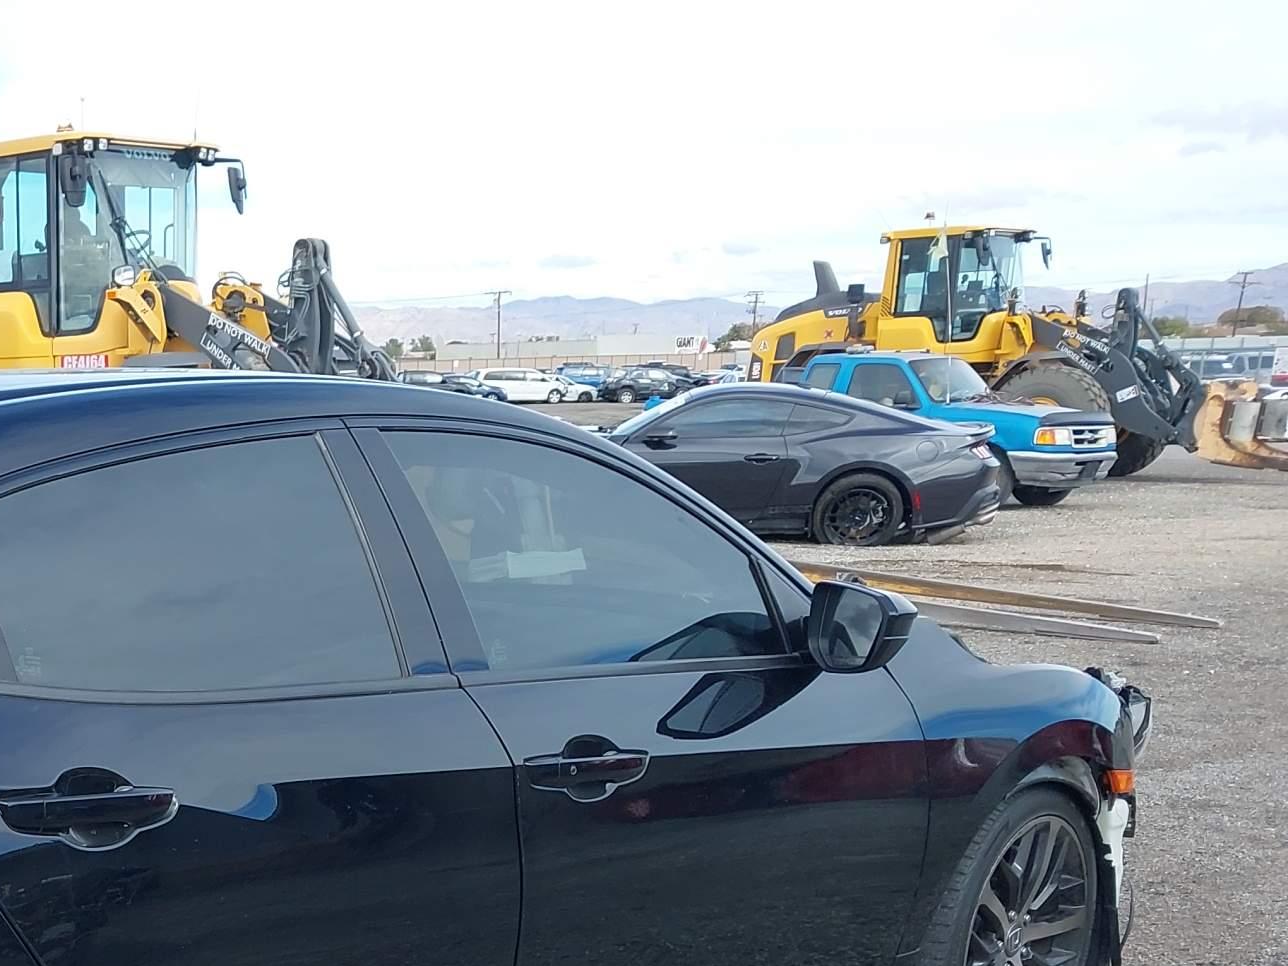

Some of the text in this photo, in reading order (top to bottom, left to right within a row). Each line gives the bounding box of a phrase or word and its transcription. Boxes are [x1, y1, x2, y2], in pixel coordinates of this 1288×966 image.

[125, 149, 171, 160] VOLVO
[210, 316, 269, 357] DO NOT WALK
[676, 336, 695, 348] GIANT
[1064, 329, 1075, 338] DO
[1075, 333, 1090, 345] NOT
[206, 339, 233, 369] UNDER
[1060, 346, 1096, 373] UNDER MAST
